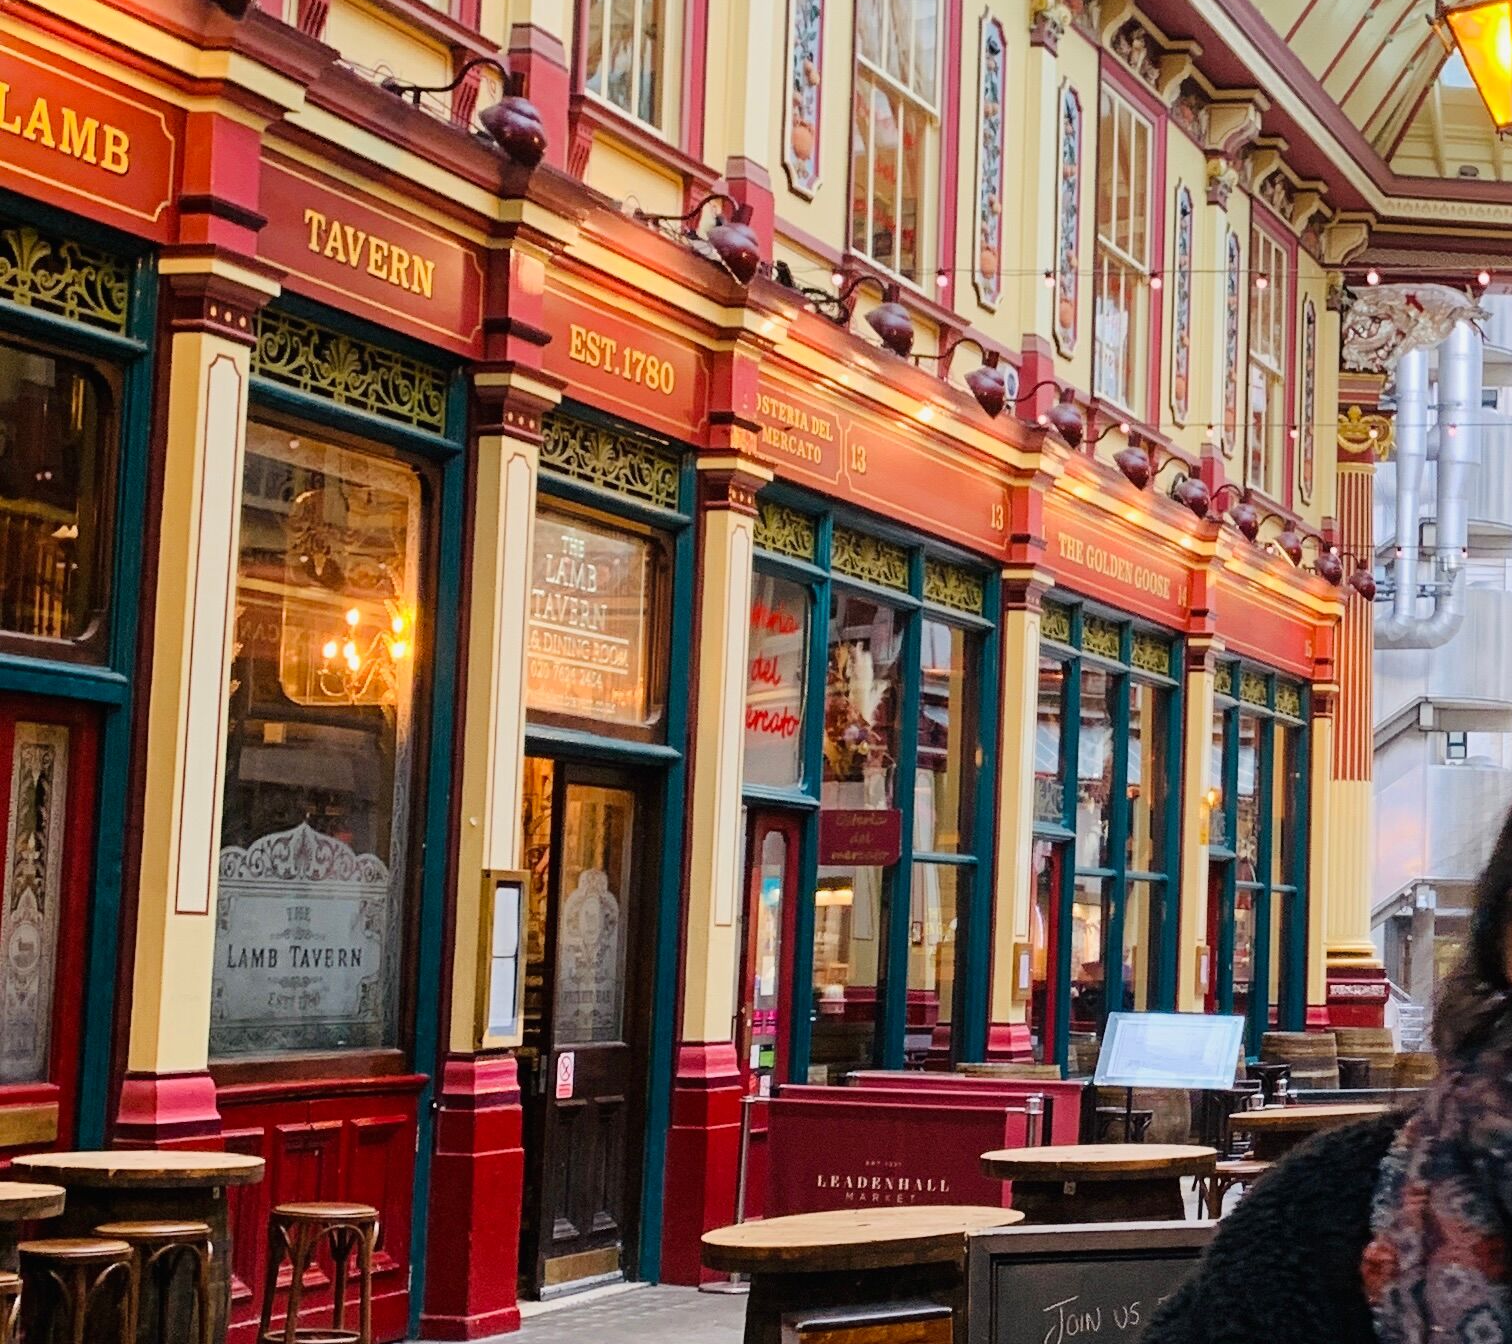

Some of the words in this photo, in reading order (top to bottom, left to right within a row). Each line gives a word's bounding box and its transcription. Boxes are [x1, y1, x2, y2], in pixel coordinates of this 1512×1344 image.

[0, 81, 130, 175] LAMB
[303, 208, 436, 298] TAVERN
[811, 415, 834, 442] DEL
[761, 423, 822, 465] MERCATO
[851, 444, 867, 474] 13
[991, 504, 1004, 531] 13
[561, 535, 585, 558] THE
[545, 553, 598, 594] LAMB
[1058, 532, 1085, 565] THE
[1086, 545, 1134, 585] GOLDEN
[1135, 566, 1171, 600] GOOSE
[531, 588, 608, 631] TAVERN
[543, 632, 590, 659] DINING
[751, 652, 781, 686] del
[287, 906, 312, 922] THE
[817, 1174, 950, 1193] LEADENHALL
[845, 1191, 916, 1205] MARKET
